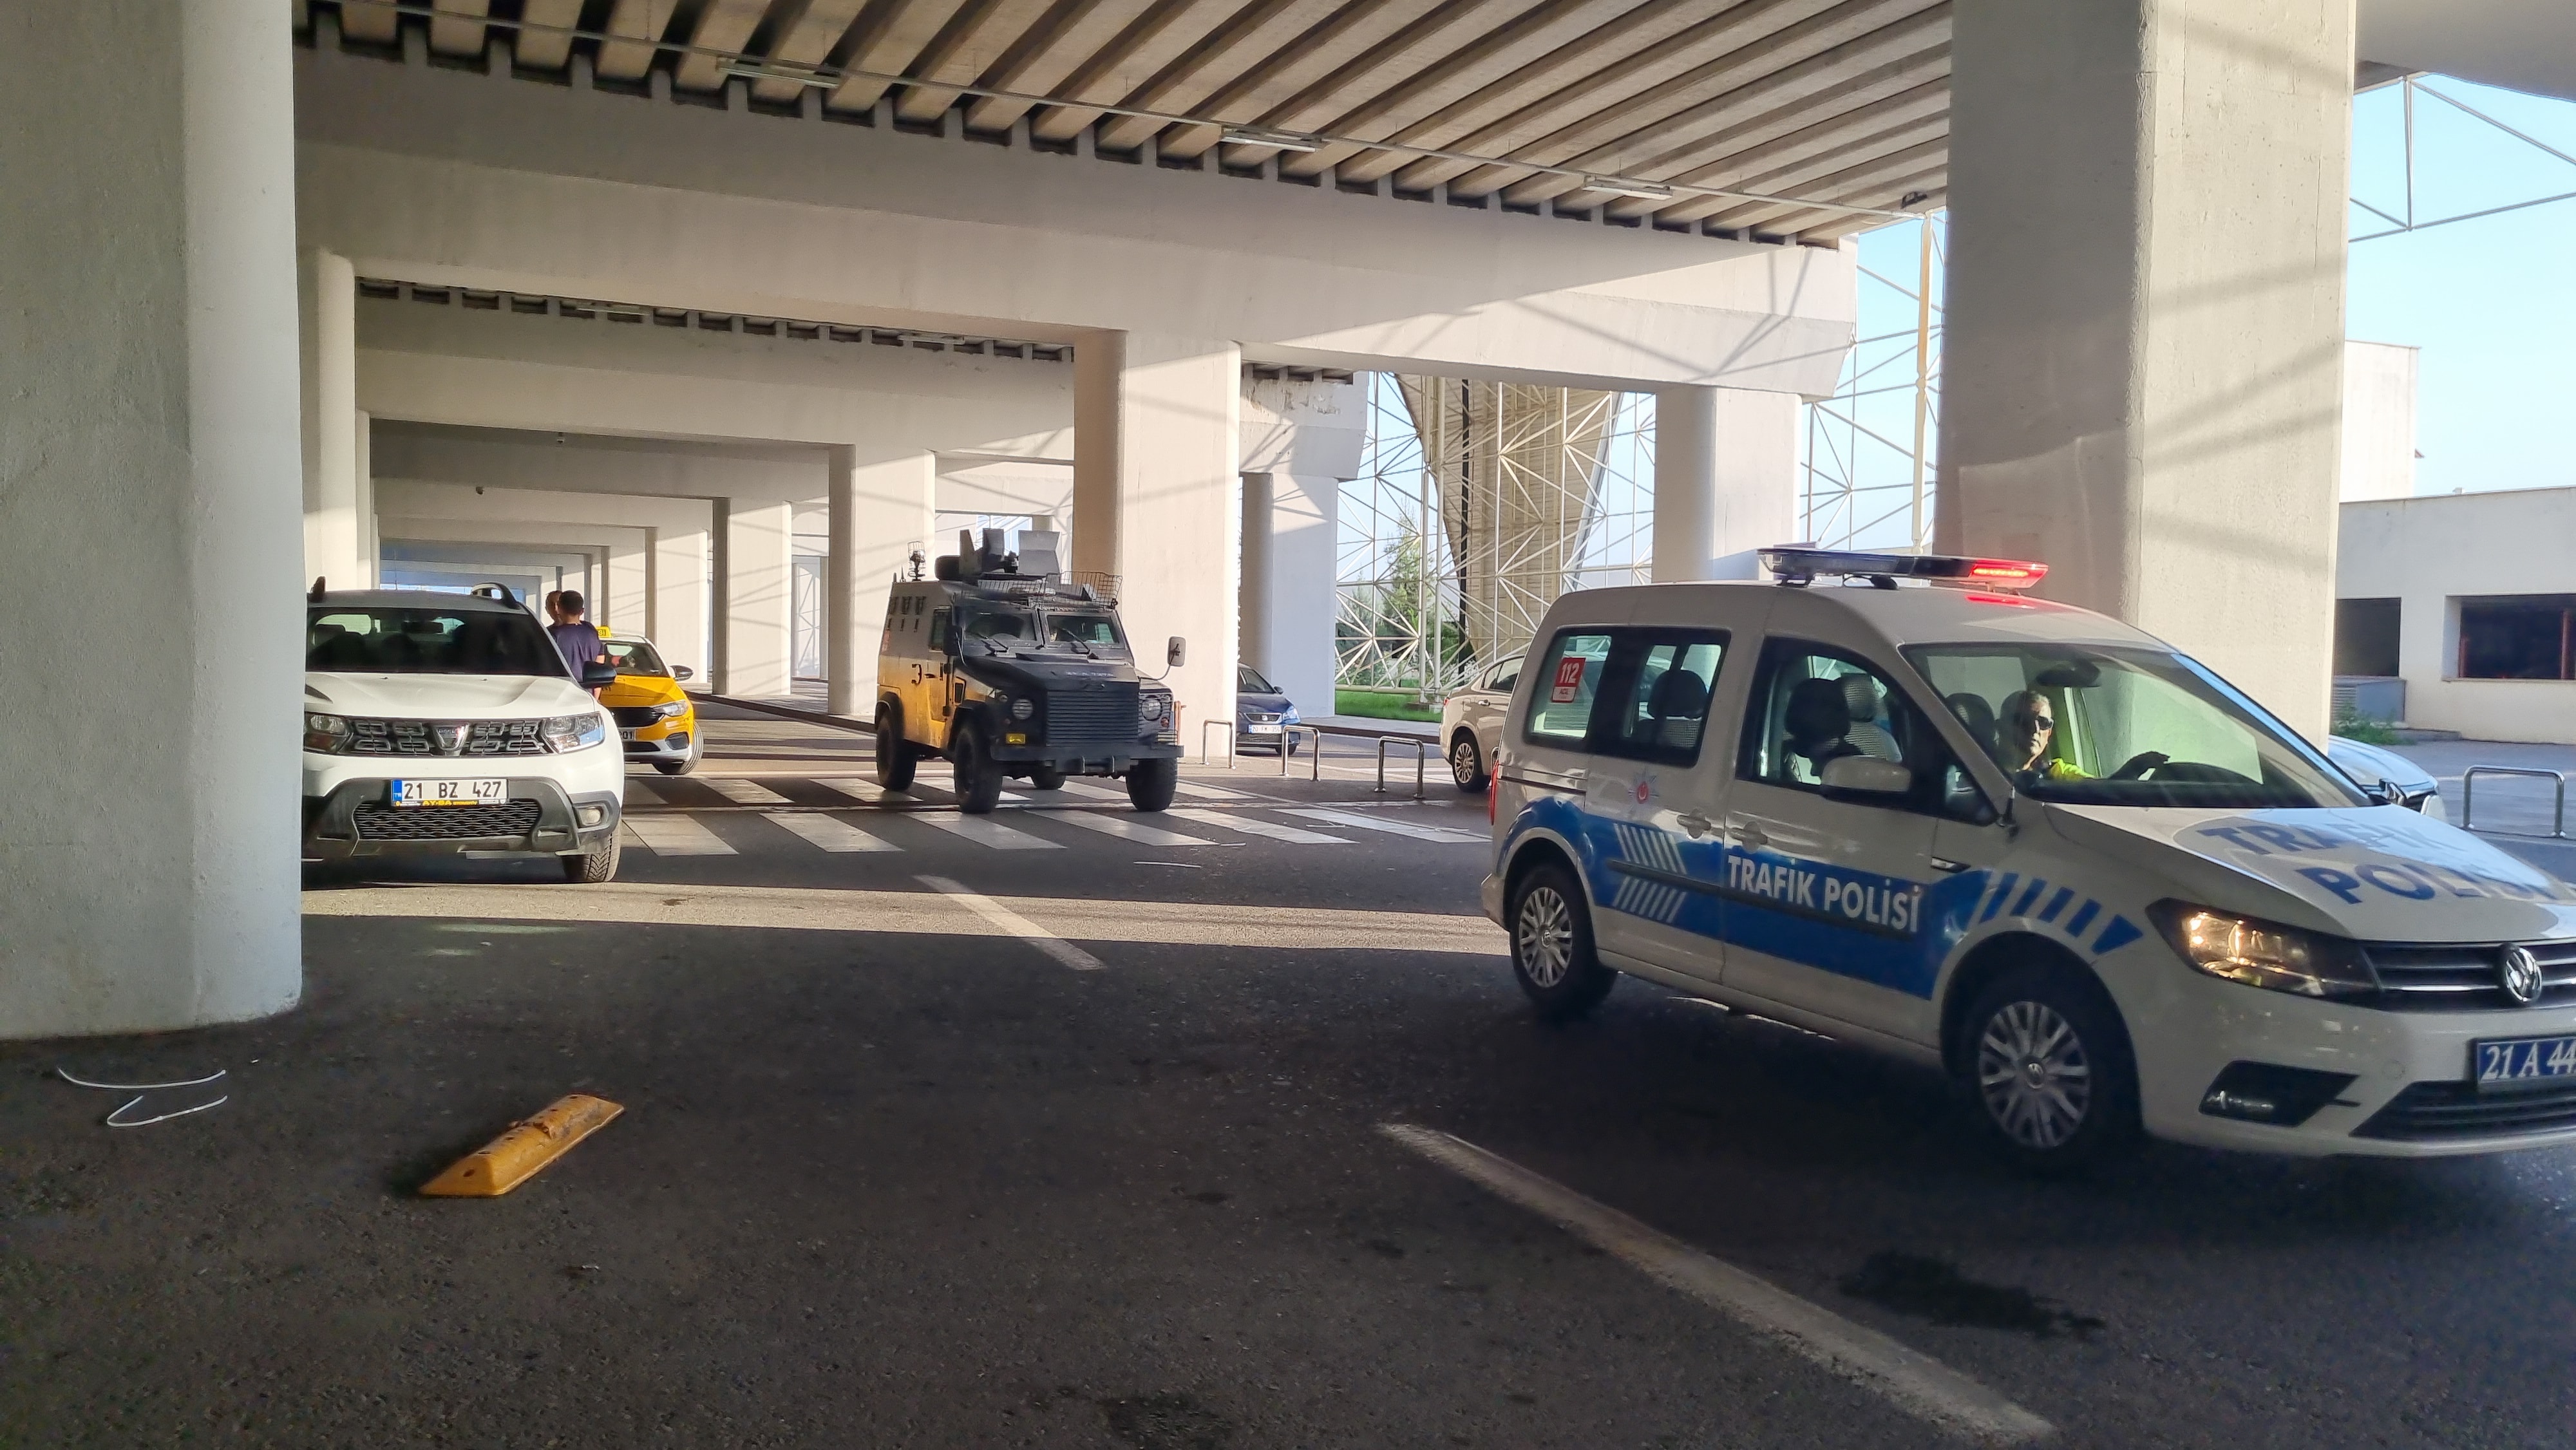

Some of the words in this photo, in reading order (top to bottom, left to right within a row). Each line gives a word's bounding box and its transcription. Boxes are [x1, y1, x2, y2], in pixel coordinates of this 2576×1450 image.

[1560, 663, 1579, 683] 112
[404, 782, 422, 799] 21
[438, 782, 459, 798] BZ
[472, 781, 502, 798] 427
[1728, 854, 1816, 908] TRAFİK
[1824, 876, 1920, 932] POLİSİ
[2481, 1044, 2514, 1081] 21
[2517, 1041, 2541, 1078] A
